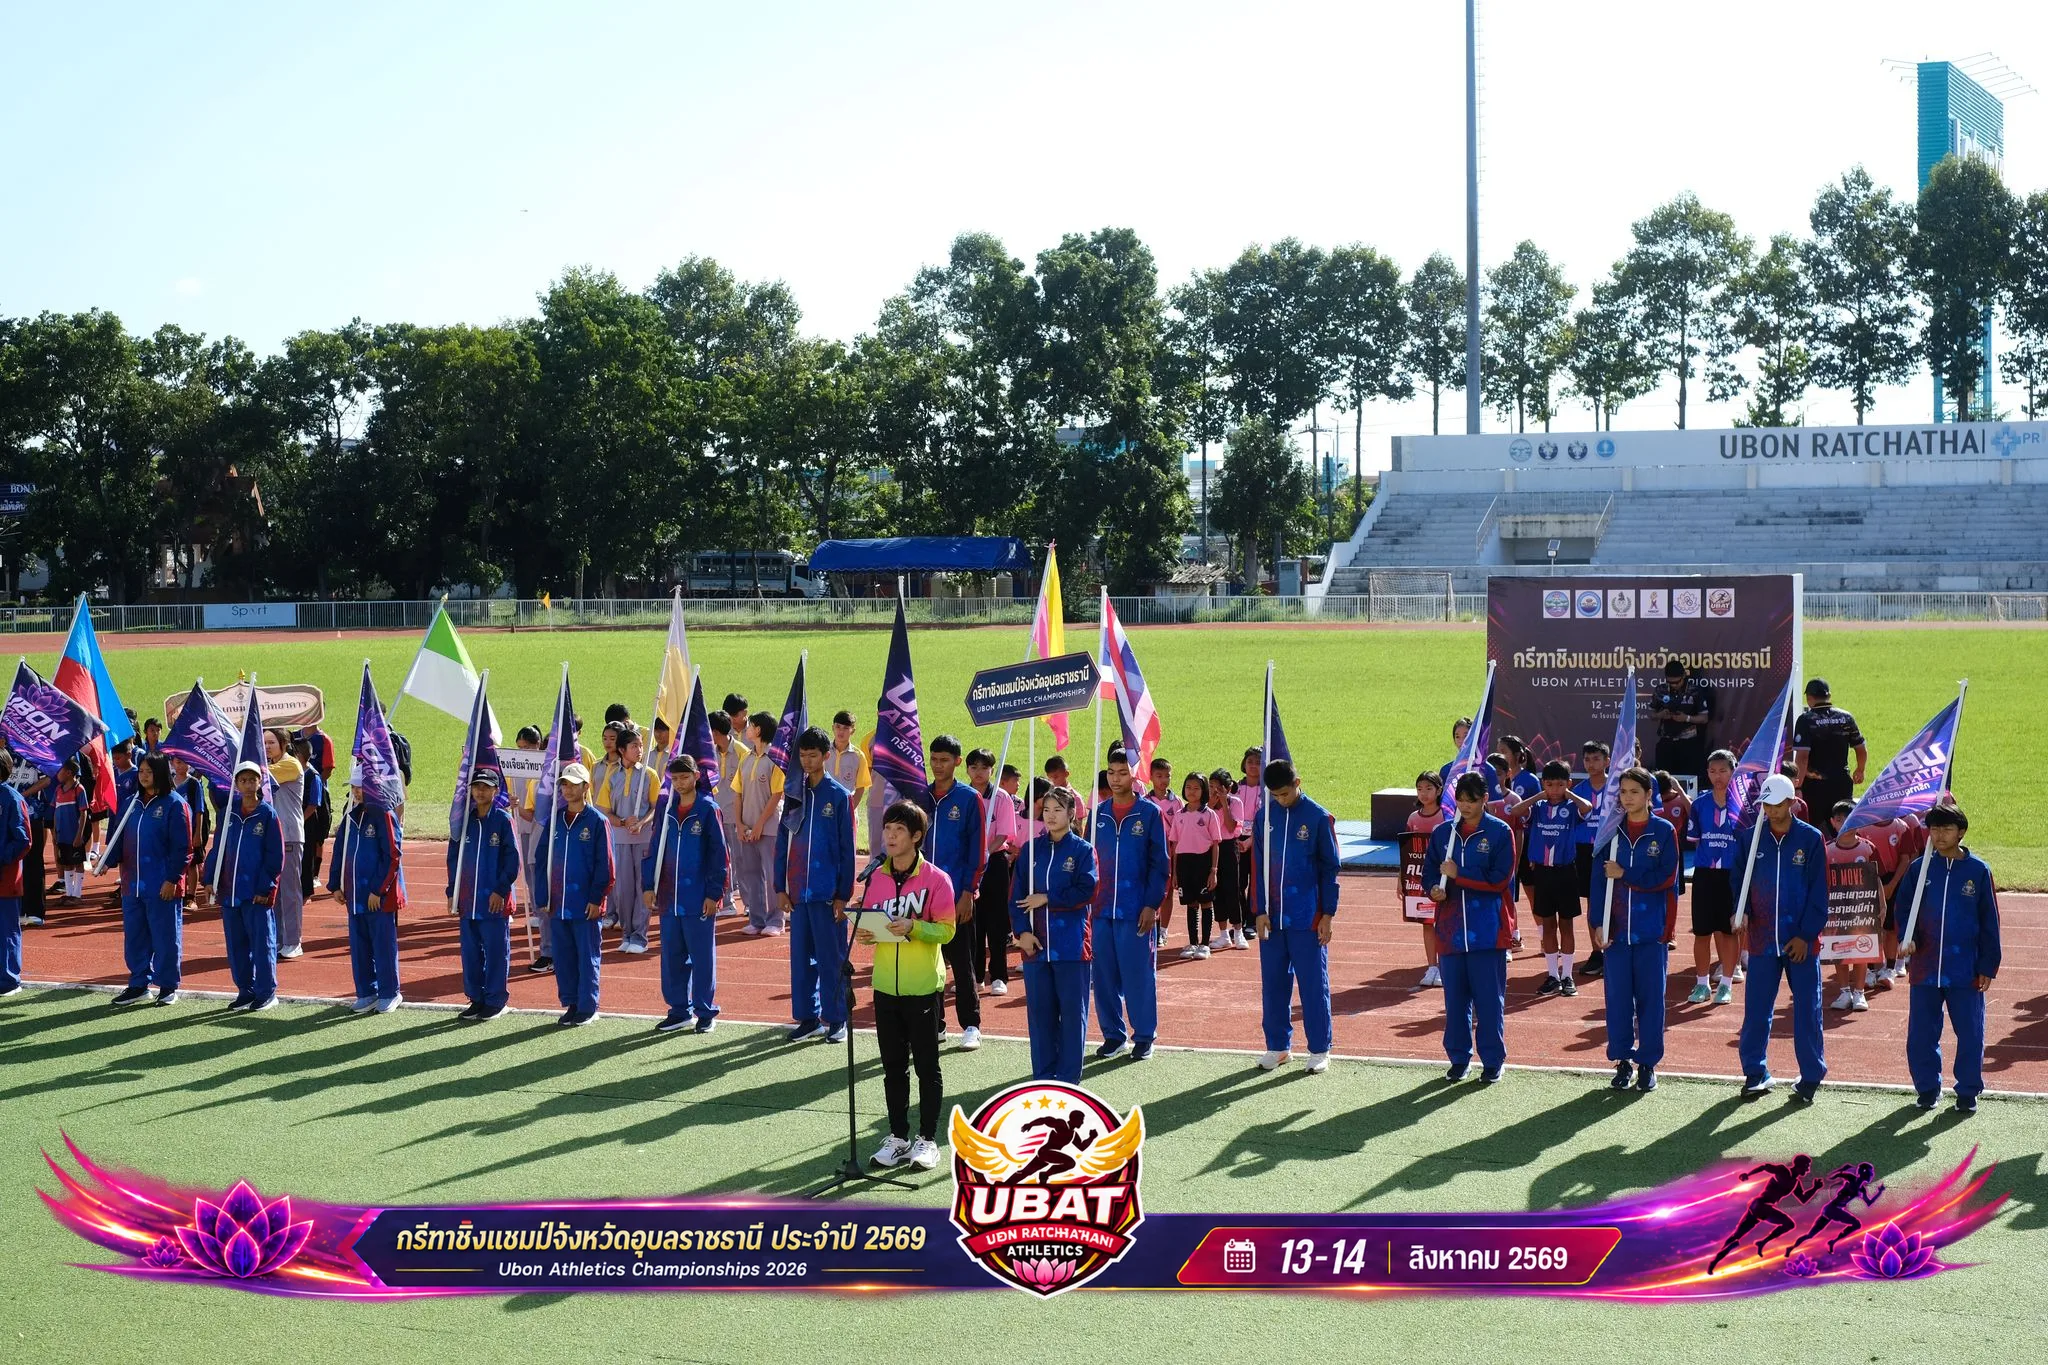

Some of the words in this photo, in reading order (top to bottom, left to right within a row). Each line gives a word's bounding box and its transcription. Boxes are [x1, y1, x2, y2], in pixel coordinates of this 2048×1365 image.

[1720, 433, 1799, 459] UBON
[1812, 429, 1985, 458] RATCHATHA
[1531, 677, 1568, 687] UBON
[1574, 677, 1644, 688] ATHLETIS
[1650, 677, 1755, 688] CHPIONSHIPS
[976, 703, 995, 713] UBON
[997, 697, 1032, 710] ATHLETICS
[1033, 687, 1086, 703] CHAMPIONSHIPS
[1592, 701, 1602, 709] 12
[190, 717, 229, 755] UB
[184, 733, 231, 766] ATHLE
[500, 758, 544, 771] ขงเจียมวิทยา
[1841, 868, 1864, 886] MOVE
[1827, 901, 1875, 915] ระชาชนมีค่า
